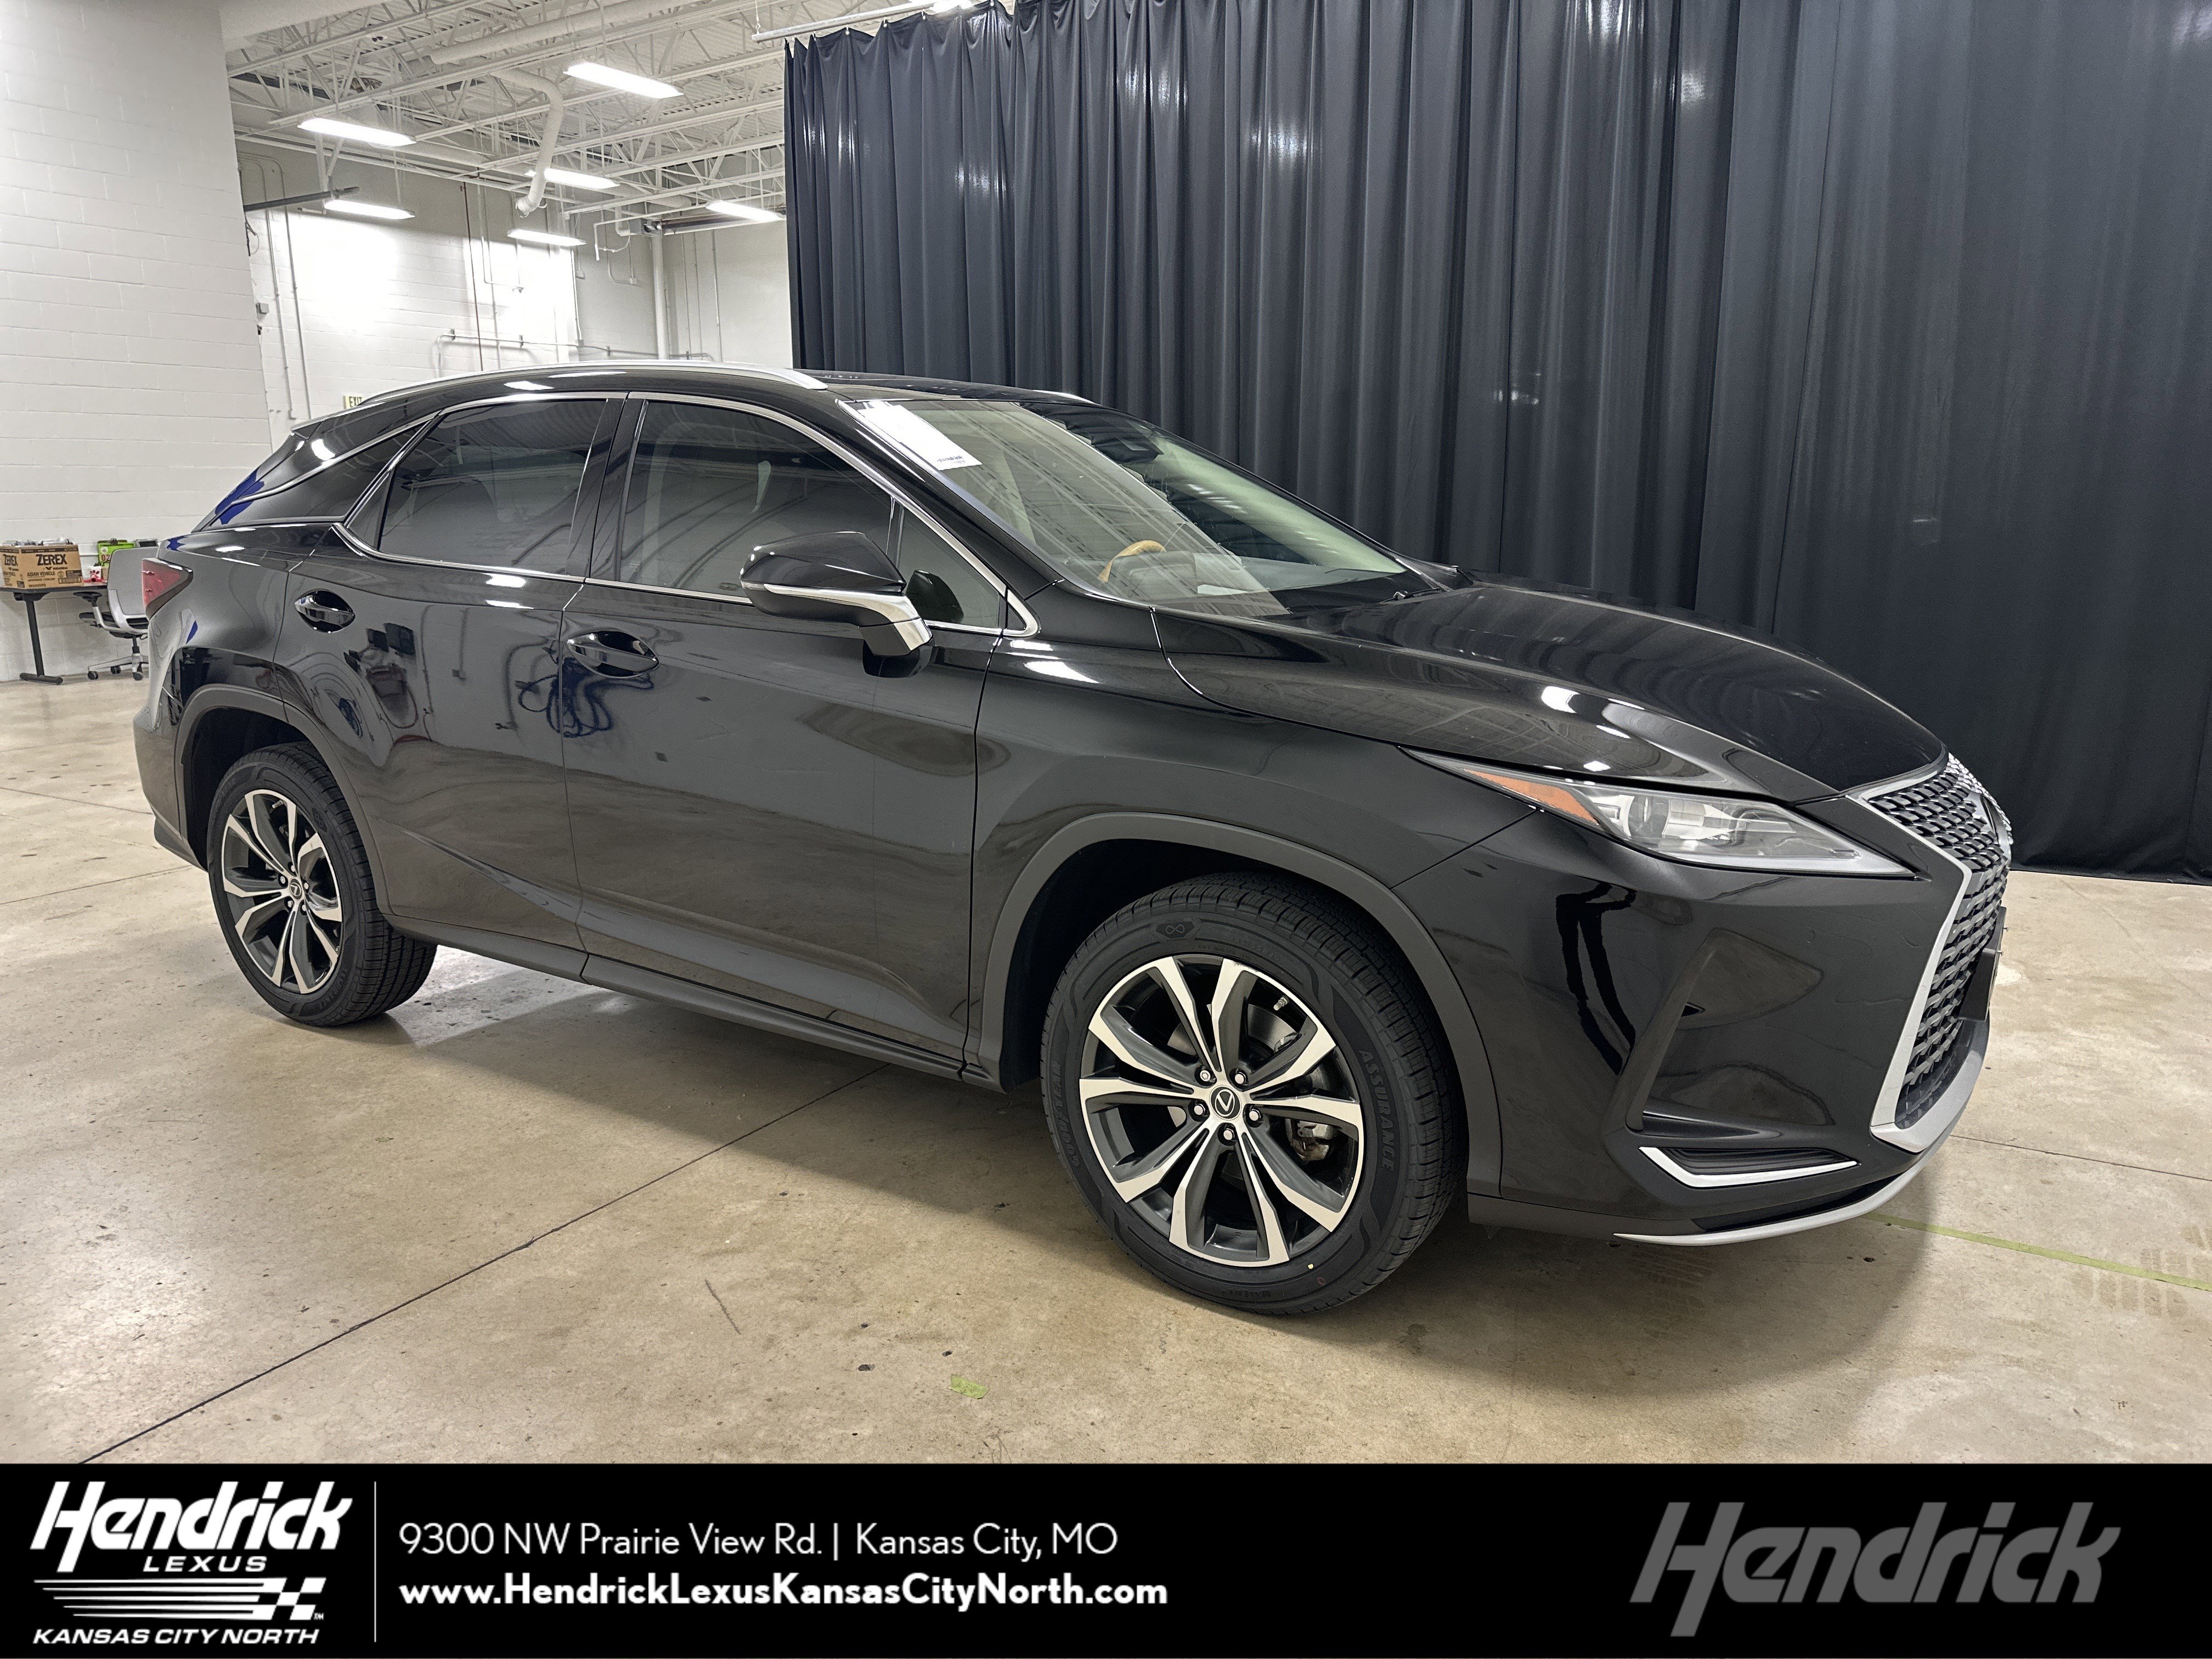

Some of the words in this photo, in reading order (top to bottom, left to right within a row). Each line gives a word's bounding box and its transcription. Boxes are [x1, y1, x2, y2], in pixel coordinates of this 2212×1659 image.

[36, 554, 67, 566] ZEREX
[1050, 1060, 1080, 1167] GOODYEAR
[1359, 1049, 1395, 1171] ASSURANCE
